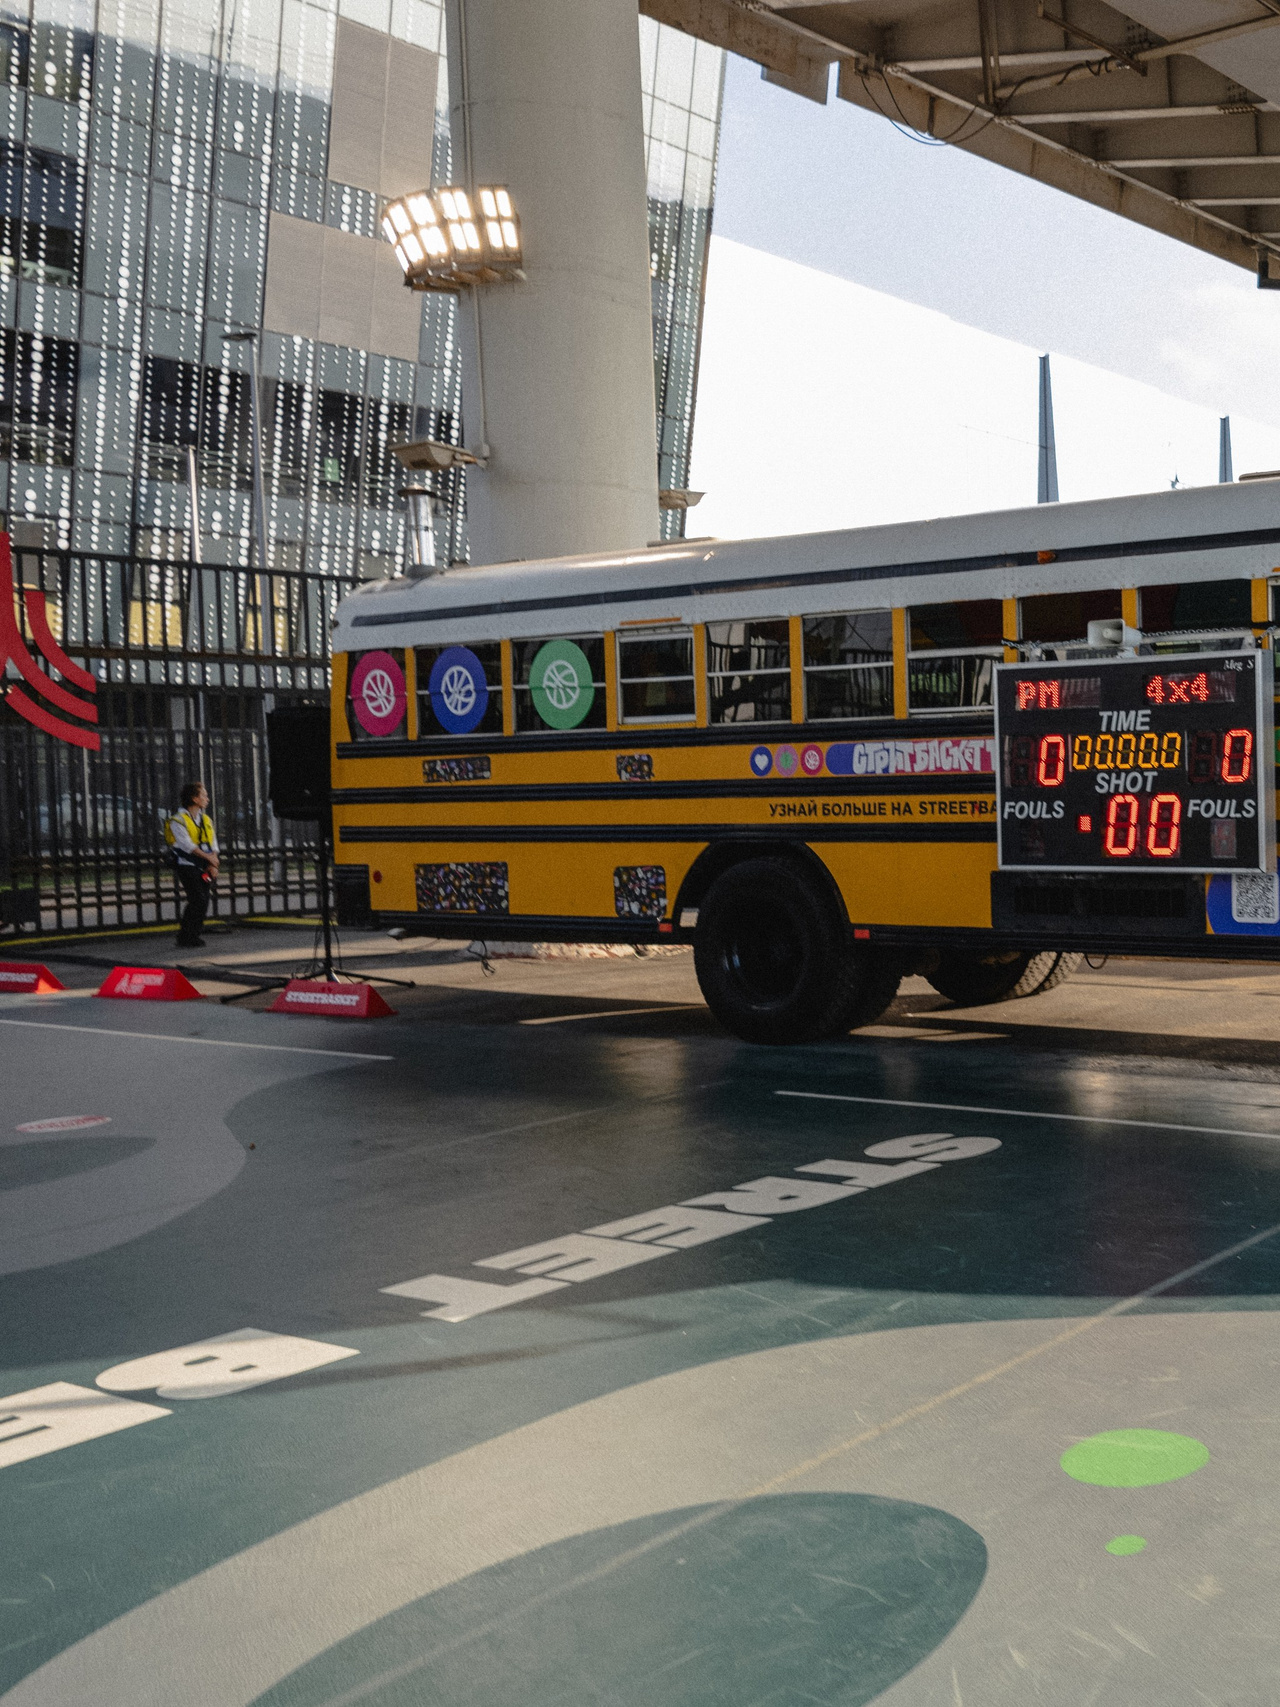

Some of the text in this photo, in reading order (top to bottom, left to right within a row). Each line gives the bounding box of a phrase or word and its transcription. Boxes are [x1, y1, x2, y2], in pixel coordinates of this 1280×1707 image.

[1017, 681, 1060, 710] PM
[1146, 672, 1210, 704] 4x4
[1099, 709, 1152, 732] TIME
[1037, 734, 1066, 787] 0
[1221, 728, 1254, 784] 0
[1094, 770, 1158, 794] SHOT
[769, 800, 818, 817] УЗНАЙ
[822, 802, 887, 817] БОЛЬШЕ
[891, 802, 913, 817] НА
[1002, 800, 1066, 820] FOULS
[1187, 798, 1256, 819] FOULS
[378, 1132, 1003, 1324] STREET
